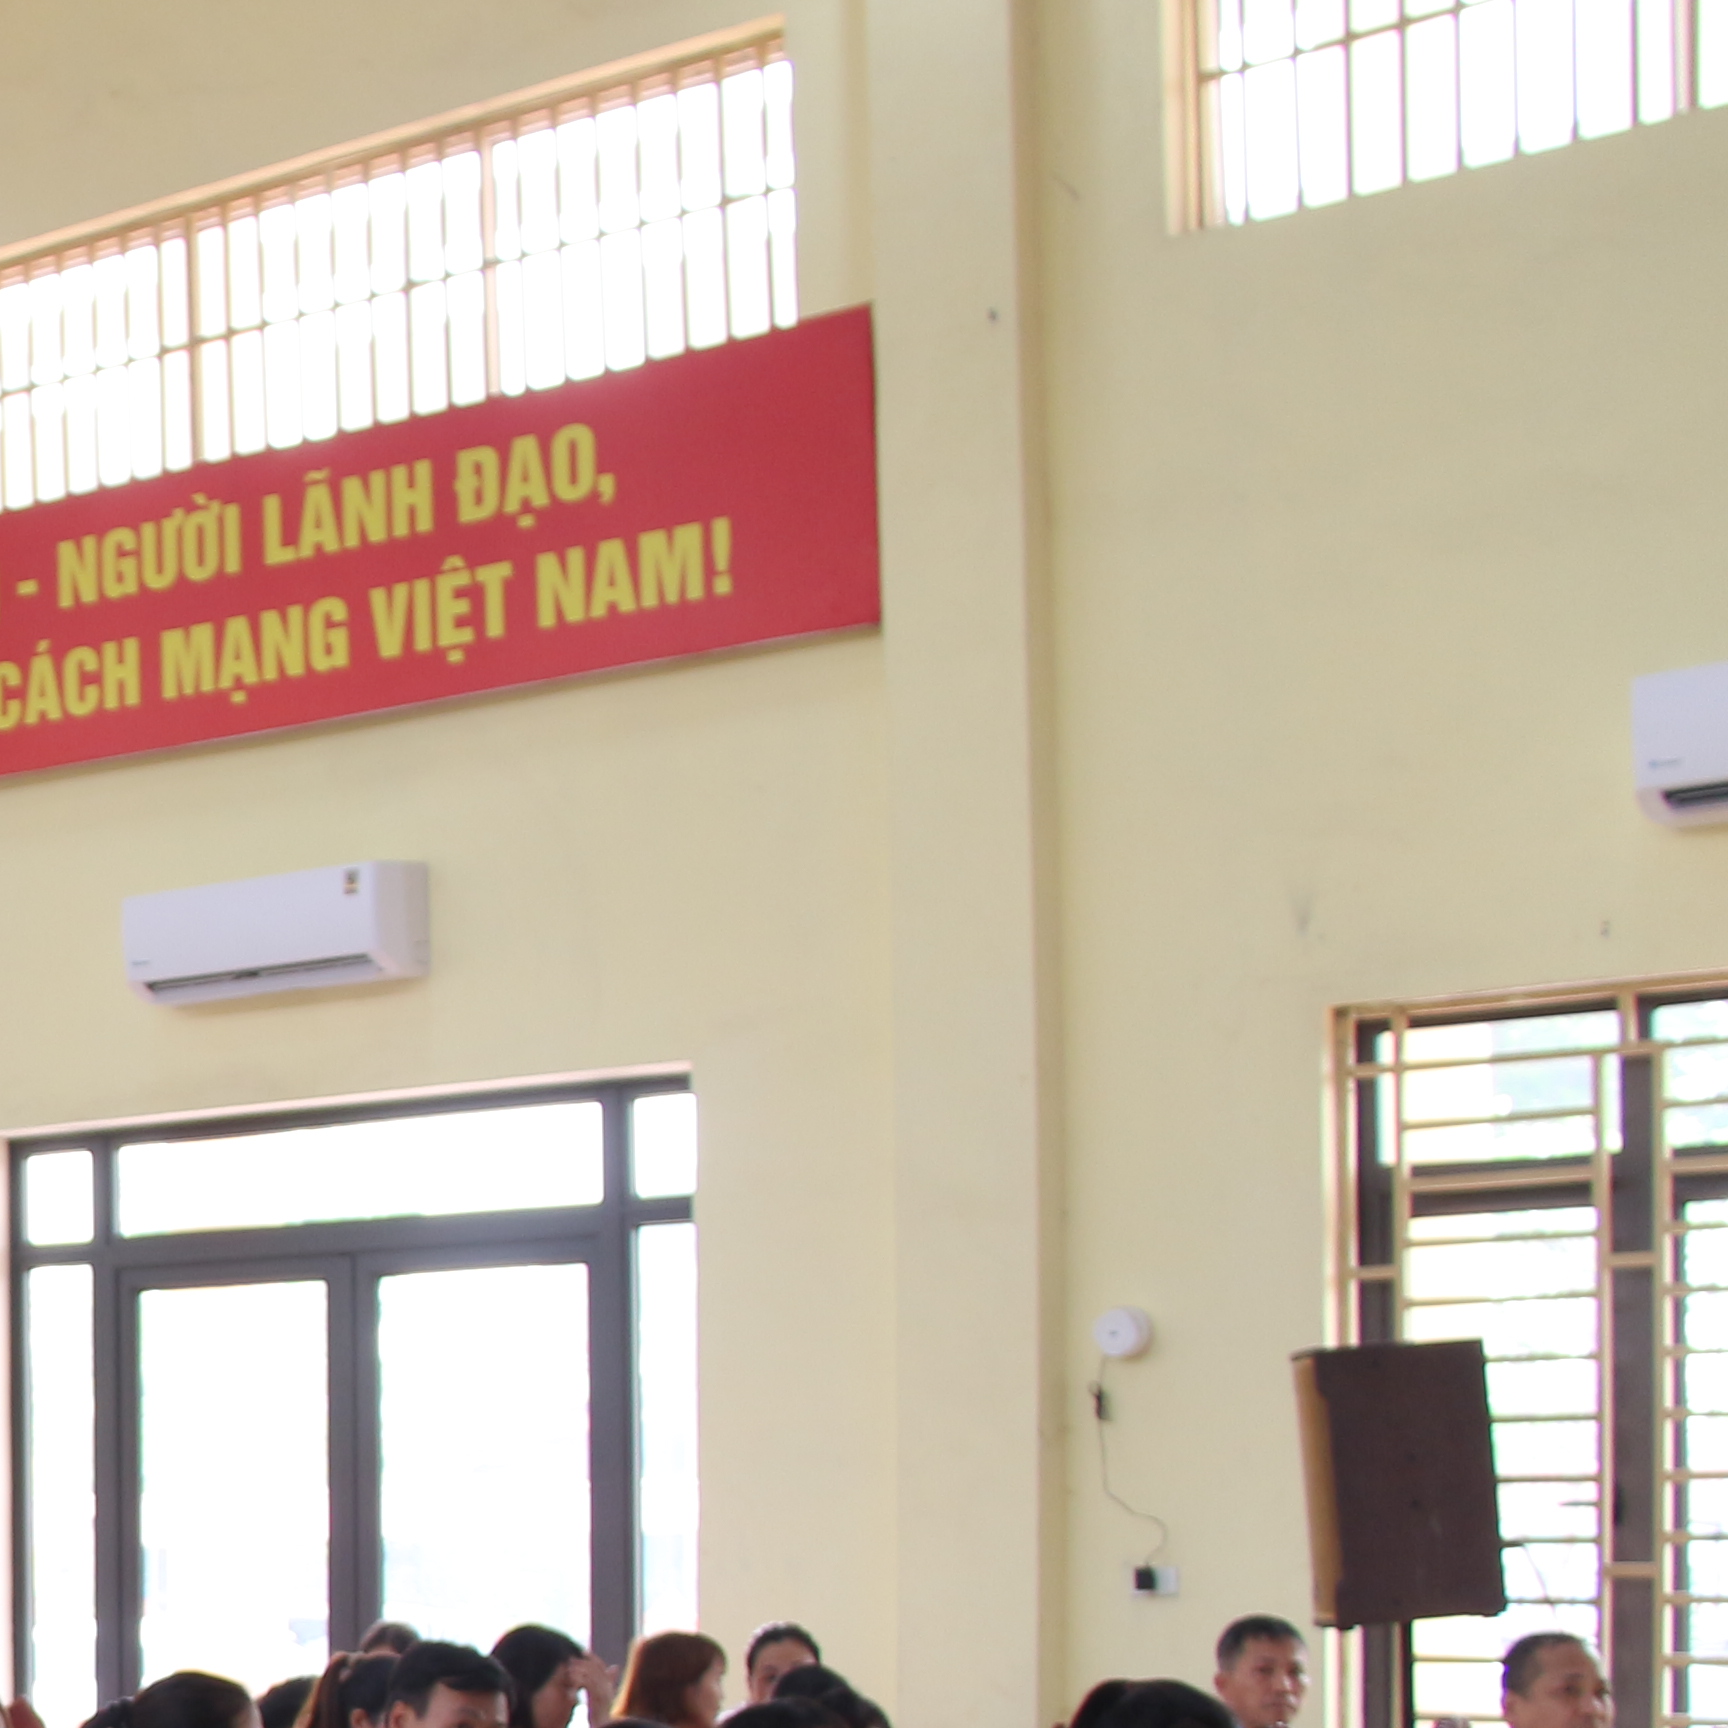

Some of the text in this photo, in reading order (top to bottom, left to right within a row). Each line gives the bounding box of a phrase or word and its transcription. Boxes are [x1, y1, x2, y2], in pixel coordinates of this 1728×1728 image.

[15, 578, 38, 597] -
[56, 494, 242, 609] NGƯỜI
[261, 468, 434, 566] LÃNH
[452, 423, 616, 527] ĐẠO,
[160, 595, 350, 704] MẠNG
[369, 556, 514, 663] VIỆT
[536, 516, 734, 629] NAM!
